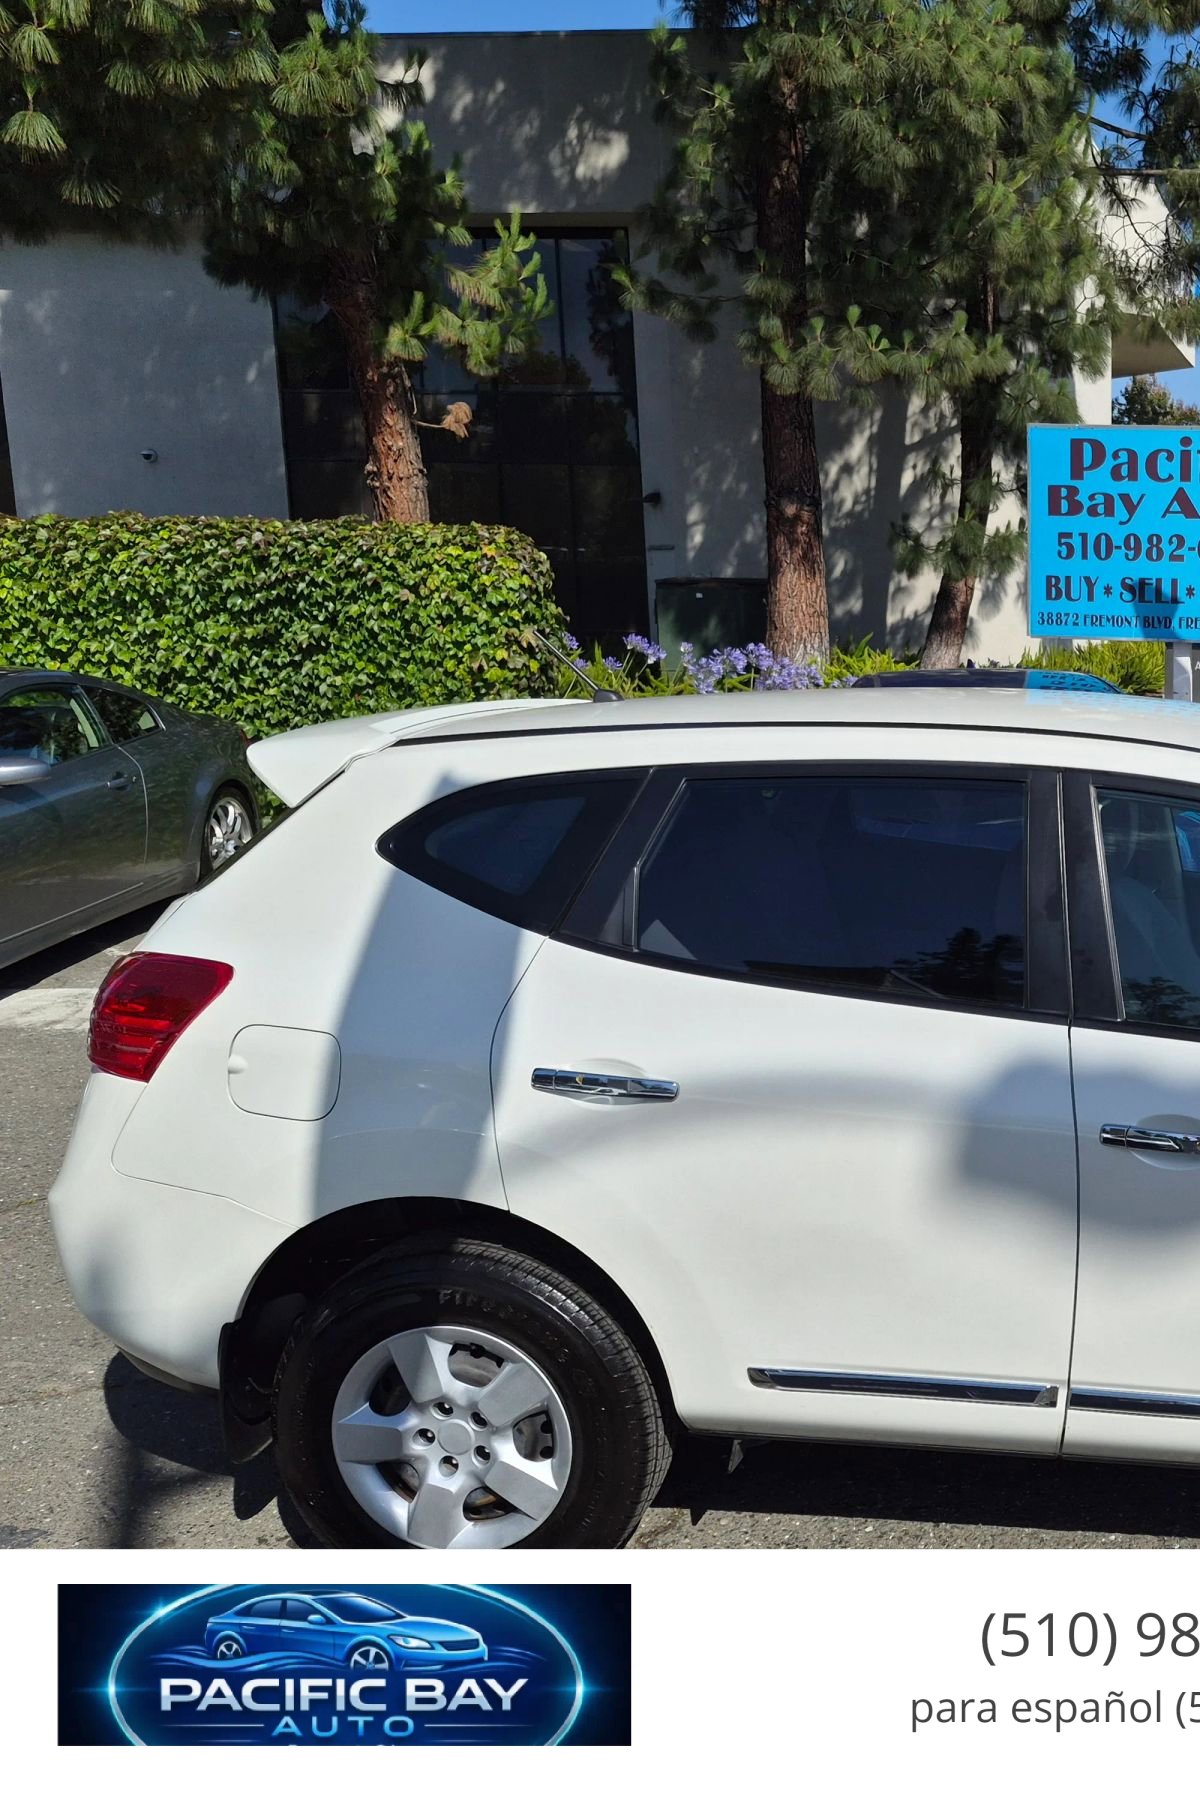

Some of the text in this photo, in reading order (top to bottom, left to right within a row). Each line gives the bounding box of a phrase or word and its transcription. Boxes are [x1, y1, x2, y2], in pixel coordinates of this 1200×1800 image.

[1047, 484, 1146, 526] Bay
[1046, 575, 1099, 603] BUY
[1120, 577, 1185, 604] SELL
[1037, 611, 1080, 627] 38872
[1083, 614, 1139, 629] FREMONT
